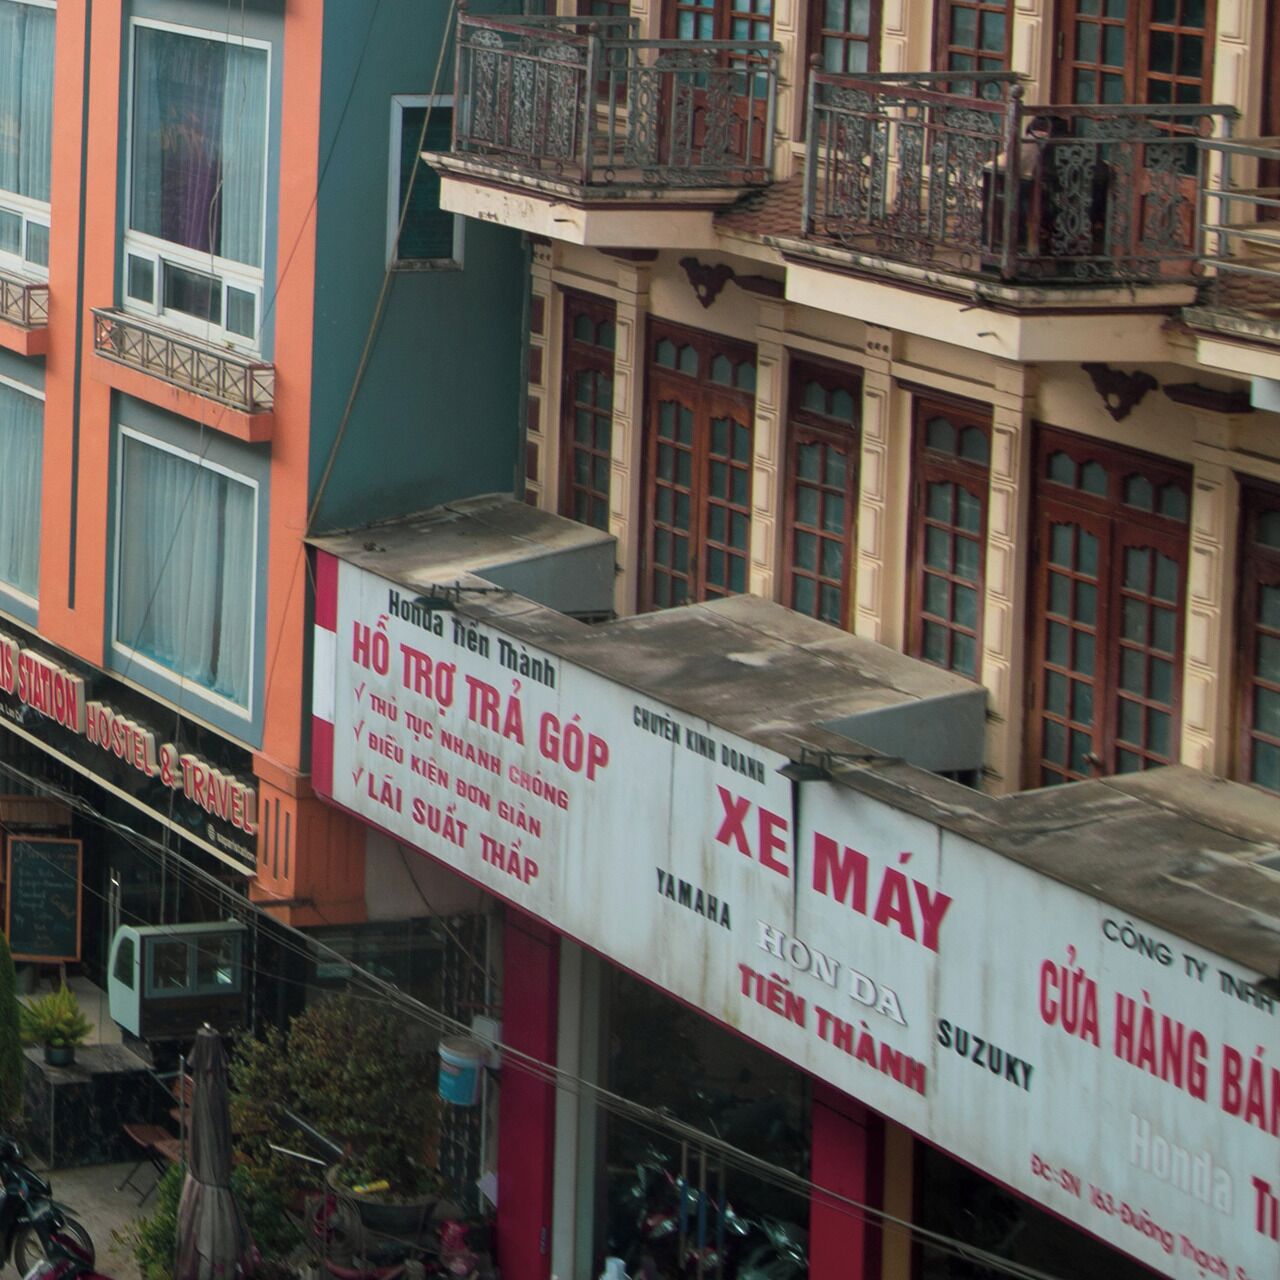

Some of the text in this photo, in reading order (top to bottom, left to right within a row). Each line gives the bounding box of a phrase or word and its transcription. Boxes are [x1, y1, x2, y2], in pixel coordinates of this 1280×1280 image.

[389, 588, 556, 689] Honda Tiến Thành
[18, 651, 82, 734] STATION
[86, 702, 156, 777] HOSTEL
[160, 743, 179, 789] &
[180, 754, 256, 835] TRAVEL
[351, 613, 610, 782] HỖ TRỢ TRẢ GÓP
[369, 692, 570, 811] THỦ TỤC NHANH CHÓNG
[410, 755, 449, 789] KIỆN
[456, 775, 491, 812] ĐƠN
[498, 799, 542, 839] GIẢN
[686, 731, 715, 760] KINH
[721, 744, 765, 784] DOANH
[368, 772, 540, 886] LÃI SUẤT THẤP
[715, 783, 954, 953] XE MÁY
[656, 866, 732, 930] YAMAHA
[1102, 918, 1278, 1015] CÔNG TY TNHH
[815, 1005, 927, 1097] THÀNH
[938, 1019, 1035, 1091] SUZUKY
[1038, 944, 1101, 1049] CỬA
[1114, 989, 1208, 1103] HÀNG
[1129, 1113, 1235, 1216] Honda
